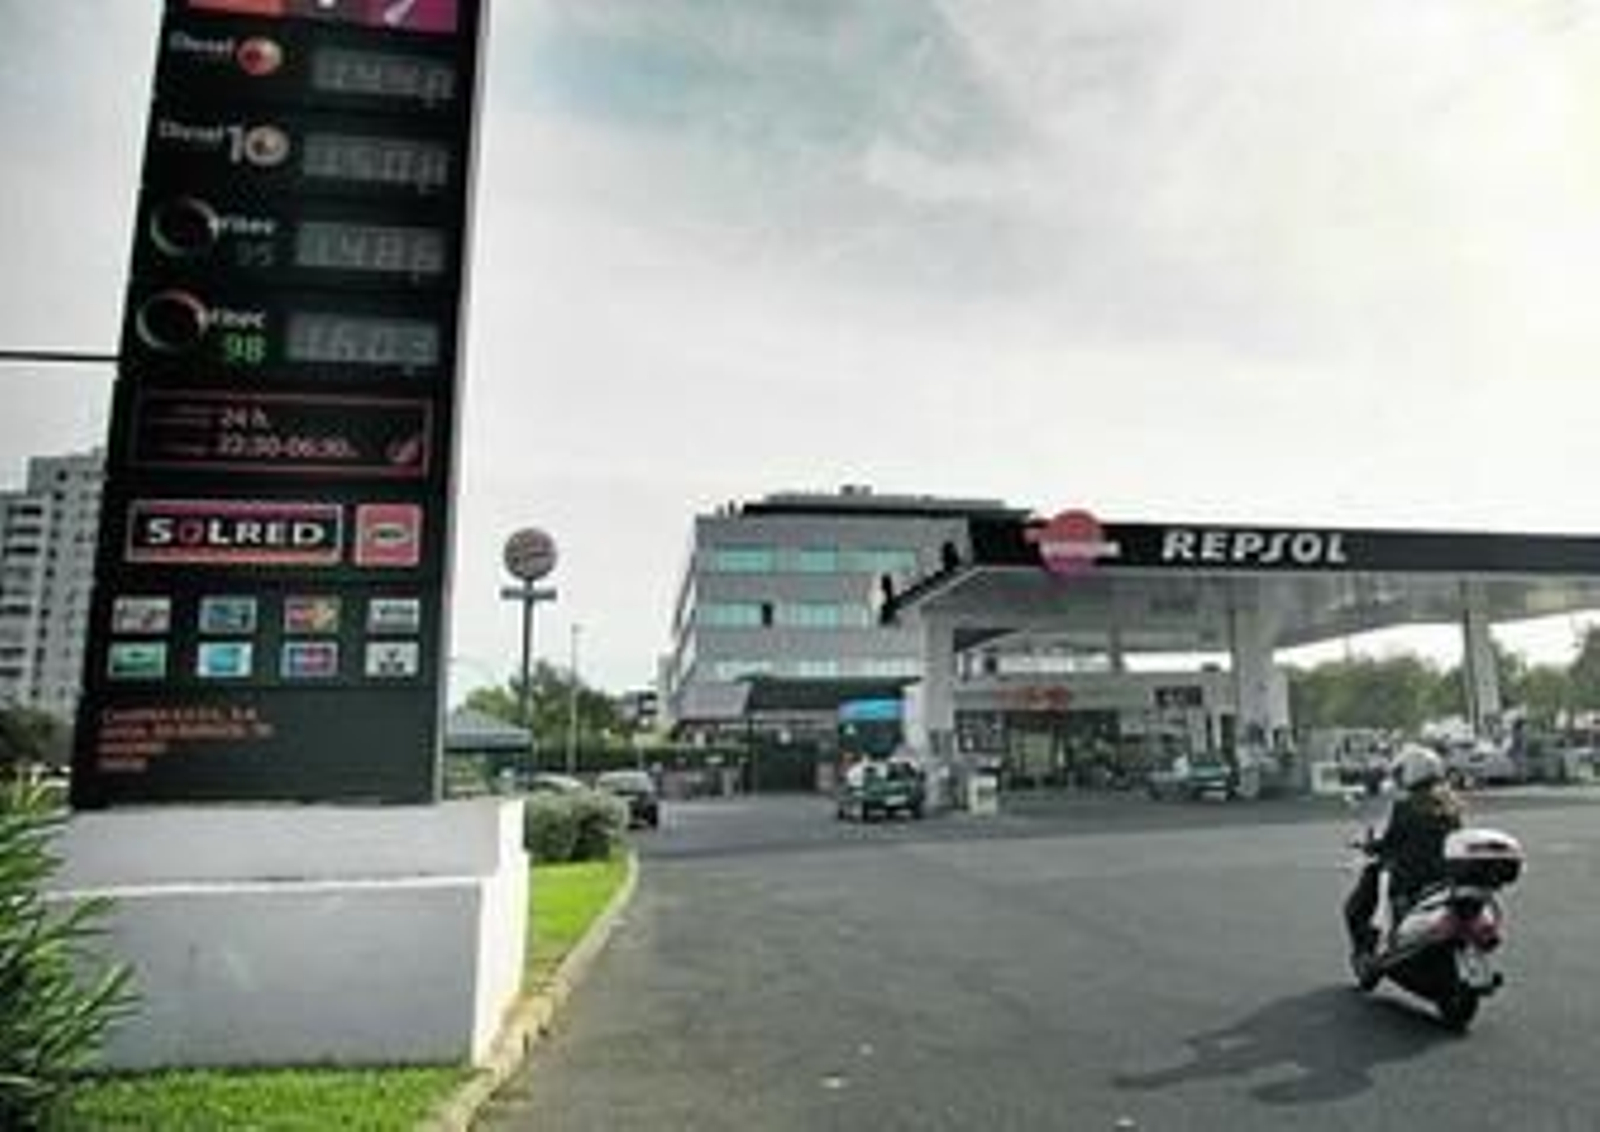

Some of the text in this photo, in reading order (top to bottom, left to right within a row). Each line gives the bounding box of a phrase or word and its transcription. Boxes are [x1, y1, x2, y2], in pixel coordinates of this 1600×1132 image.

[223, 333, 267, 363] 98
[148, 517, 326, 544] SOLRED
[1161, 528, 1348, 564] REPSOL
